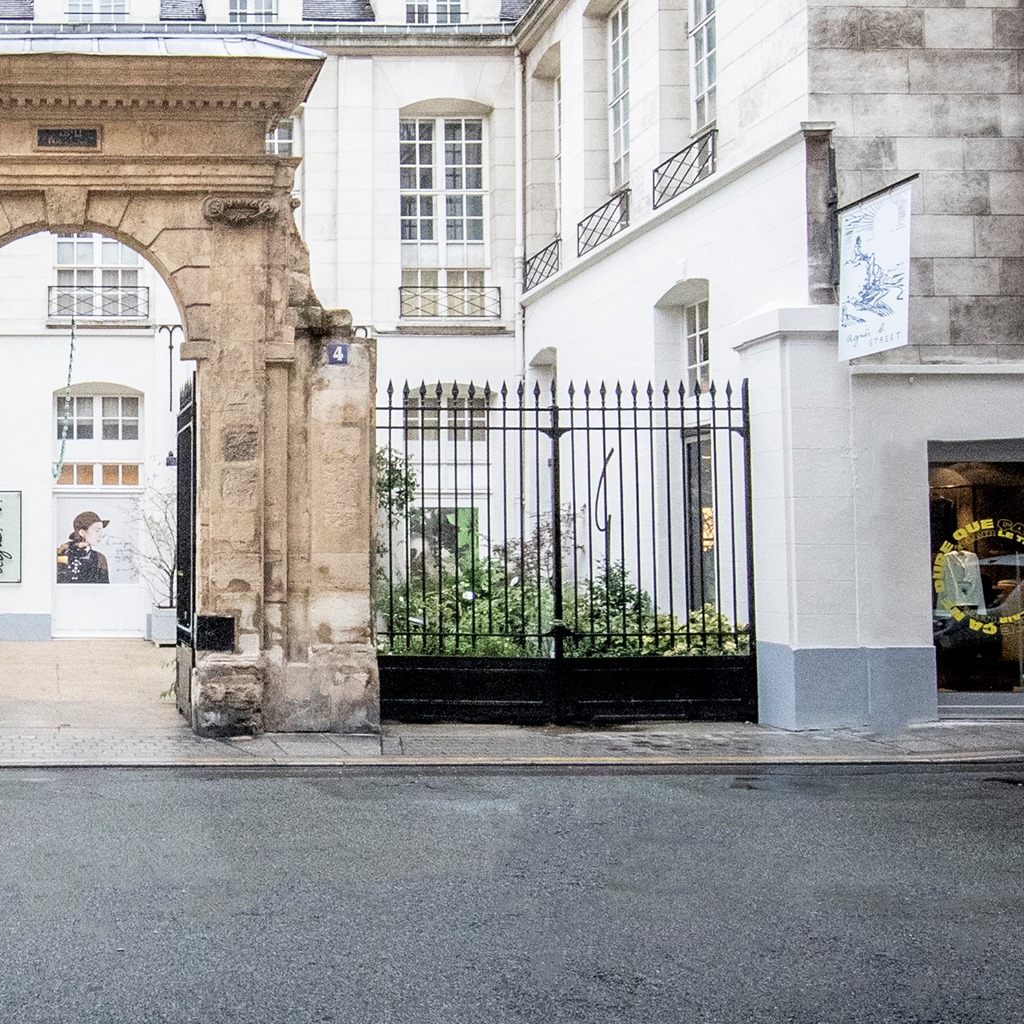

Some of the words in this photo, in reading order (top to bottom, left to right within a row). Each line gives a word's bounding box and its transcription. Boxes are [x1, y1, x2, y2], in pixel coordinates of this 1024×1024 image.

[868, 330, 901, 348] STREET
[332, 346, 344, 361] 4
[933, 540, 954, 593] DURE
[952, 518, 994, 541] QUE
